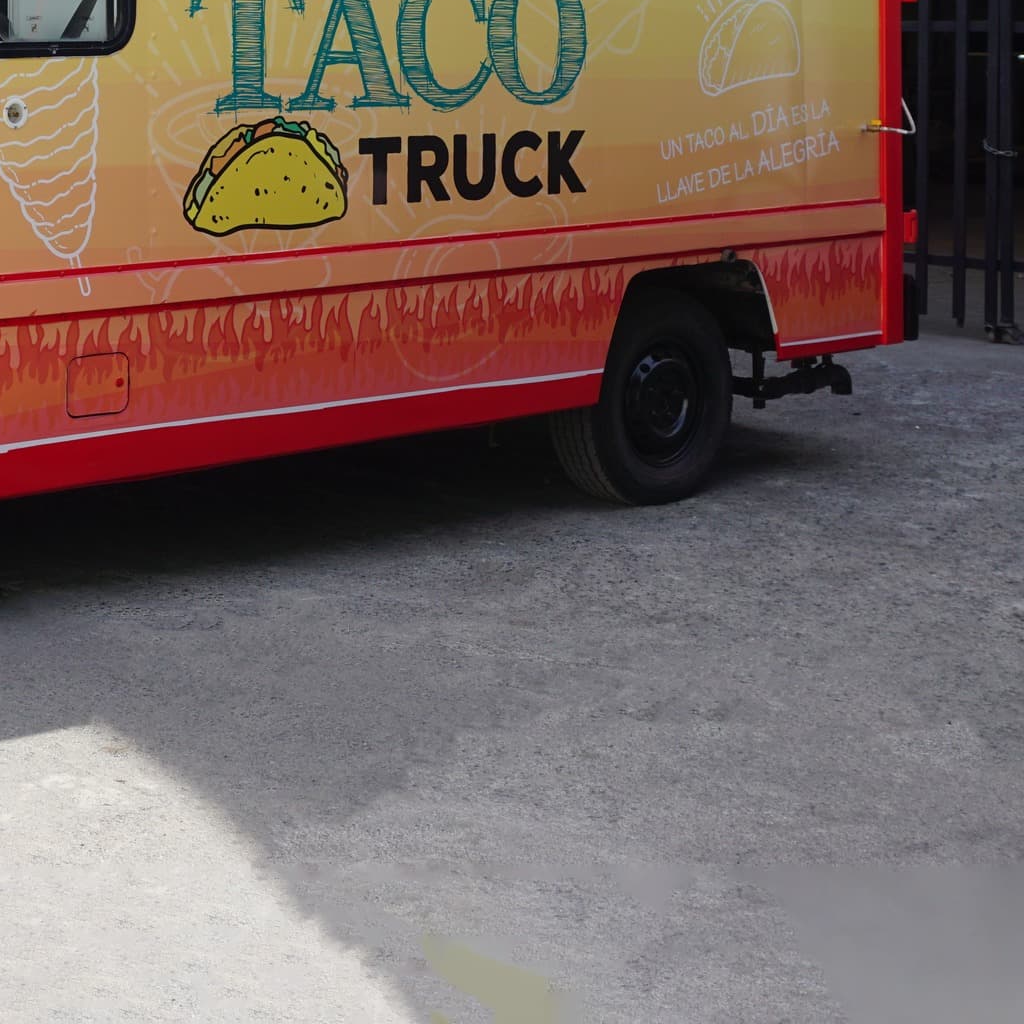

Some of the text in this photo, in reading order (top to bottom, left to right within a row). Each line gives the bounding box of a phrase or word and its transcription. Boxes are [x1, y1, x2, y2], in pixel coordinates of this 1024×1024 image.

[358, 129, 587, 206] TRUCK
[656, 128, 840, 204] LLAVE DE LA ALEGRÍA
[660, 99, 831, 160] UN TACO AL DÍA ES LA
